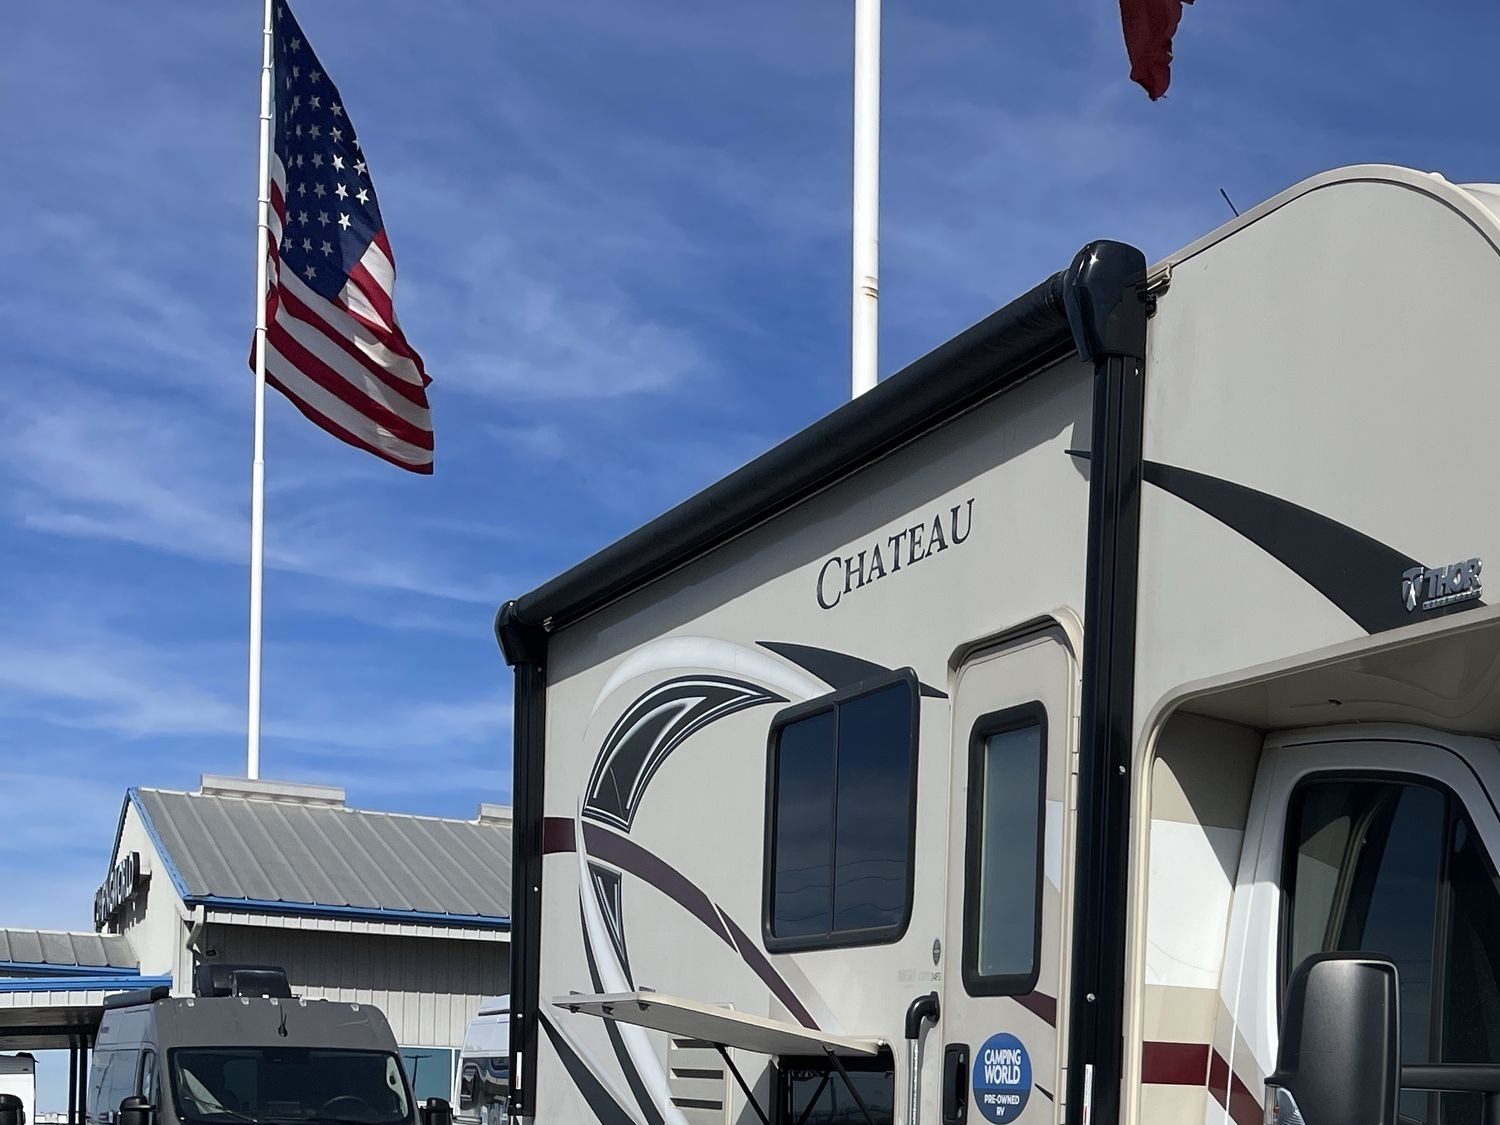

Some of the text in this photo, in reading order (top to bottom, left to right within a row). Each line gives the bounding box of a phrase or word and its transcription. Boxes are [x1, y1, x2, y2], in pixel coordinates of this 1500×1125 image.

[816, 498, 975, 610] CHATEAU
[1424, 557, 1483, 600] THOR
[984, 1049, 1021, 1065] CAMPING
[984, 1065, 1021, 1085] WORLD
[984, 1094, 1020, 1105] PRE-OWNED
[996, 1106, 1006, 1116] RV
